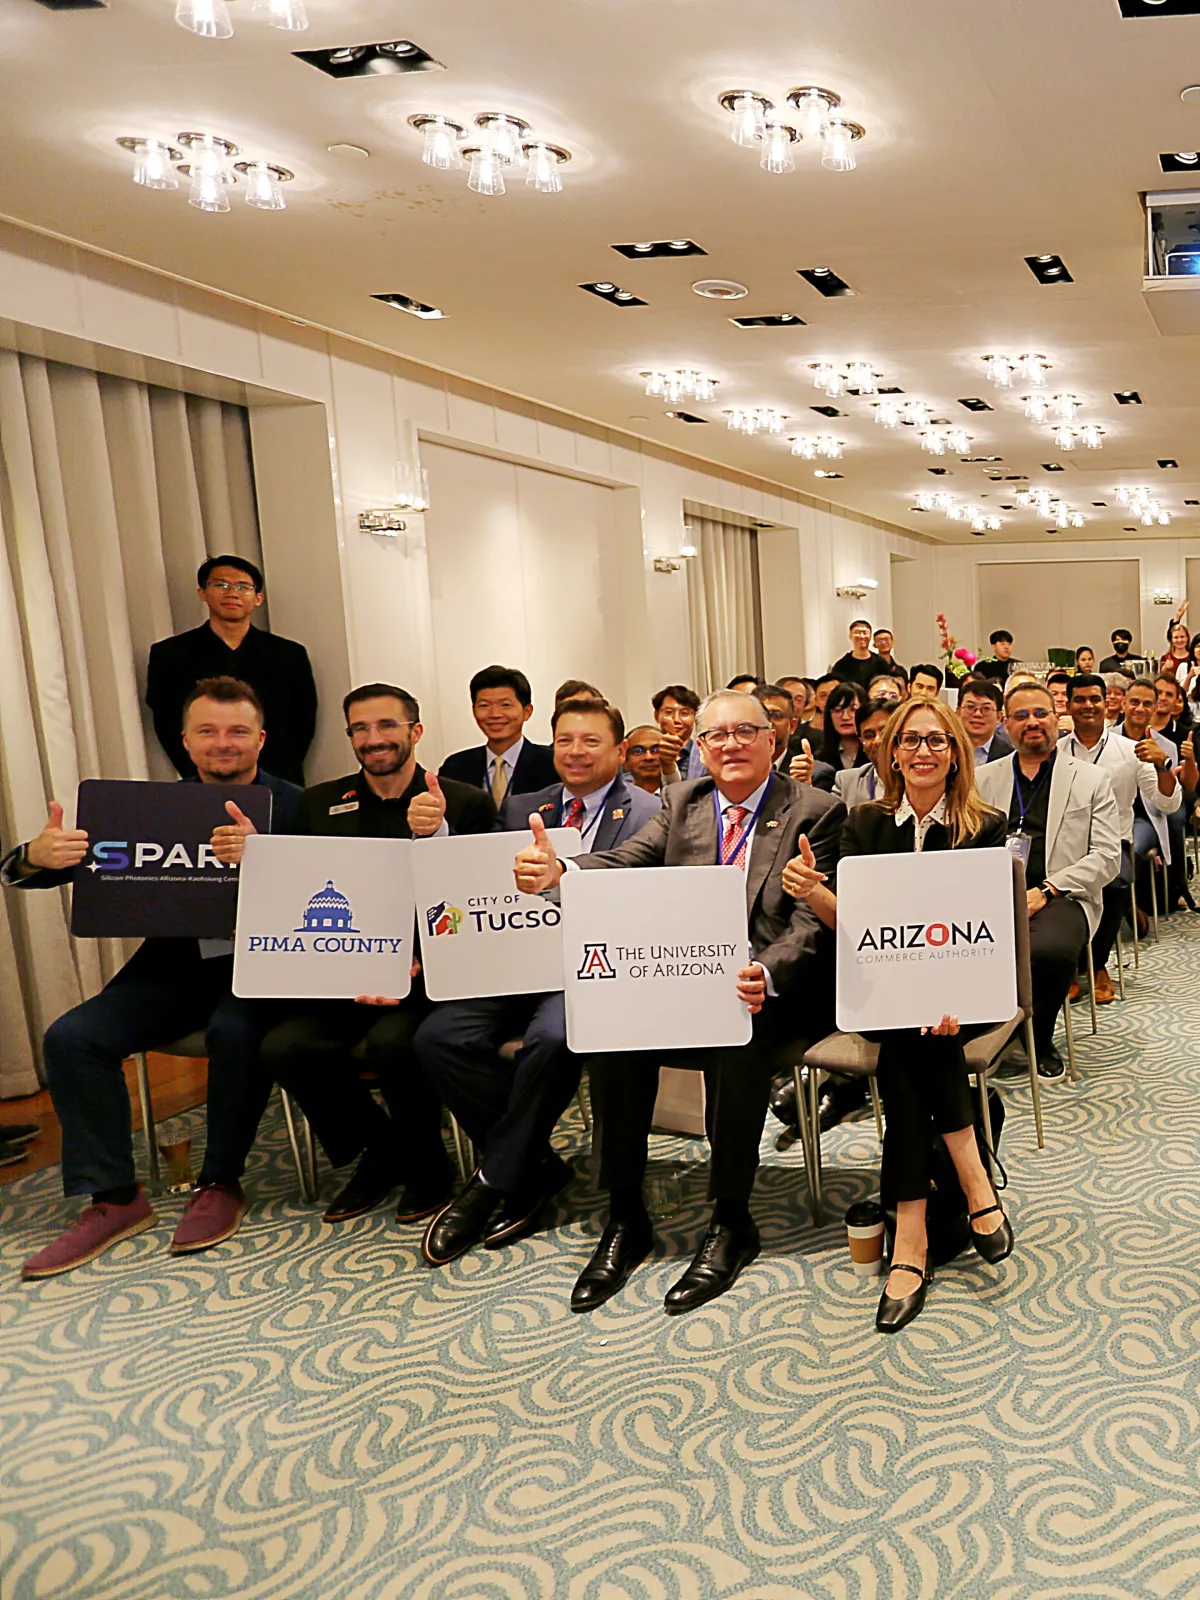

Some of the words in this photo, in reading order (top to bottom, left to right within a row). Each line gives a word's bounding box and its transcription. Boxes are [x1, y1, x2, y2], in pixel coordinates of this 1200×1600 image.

[93, 841, 238, 870] SPAR
[468, 896, 498, 906] CITY
[504, 895, 520, 904] OF
[469, 909, 561, 932] TUCSO
[857, 920, 995, 951] ARIZONA
[248, 936, 306, 952] PIMA
[313, 937, 402, 953] COUNTY
[616, 946, 645, 960] THE
[651, 944, 737, 960] UNIVERSITY
[856, 951, 924, 965] COMMERCE
[929, 947, 995, 960] AUTHORITY
[629, 965, 649, 978] OF
[653, 962, 725, 977] ARIZONA
